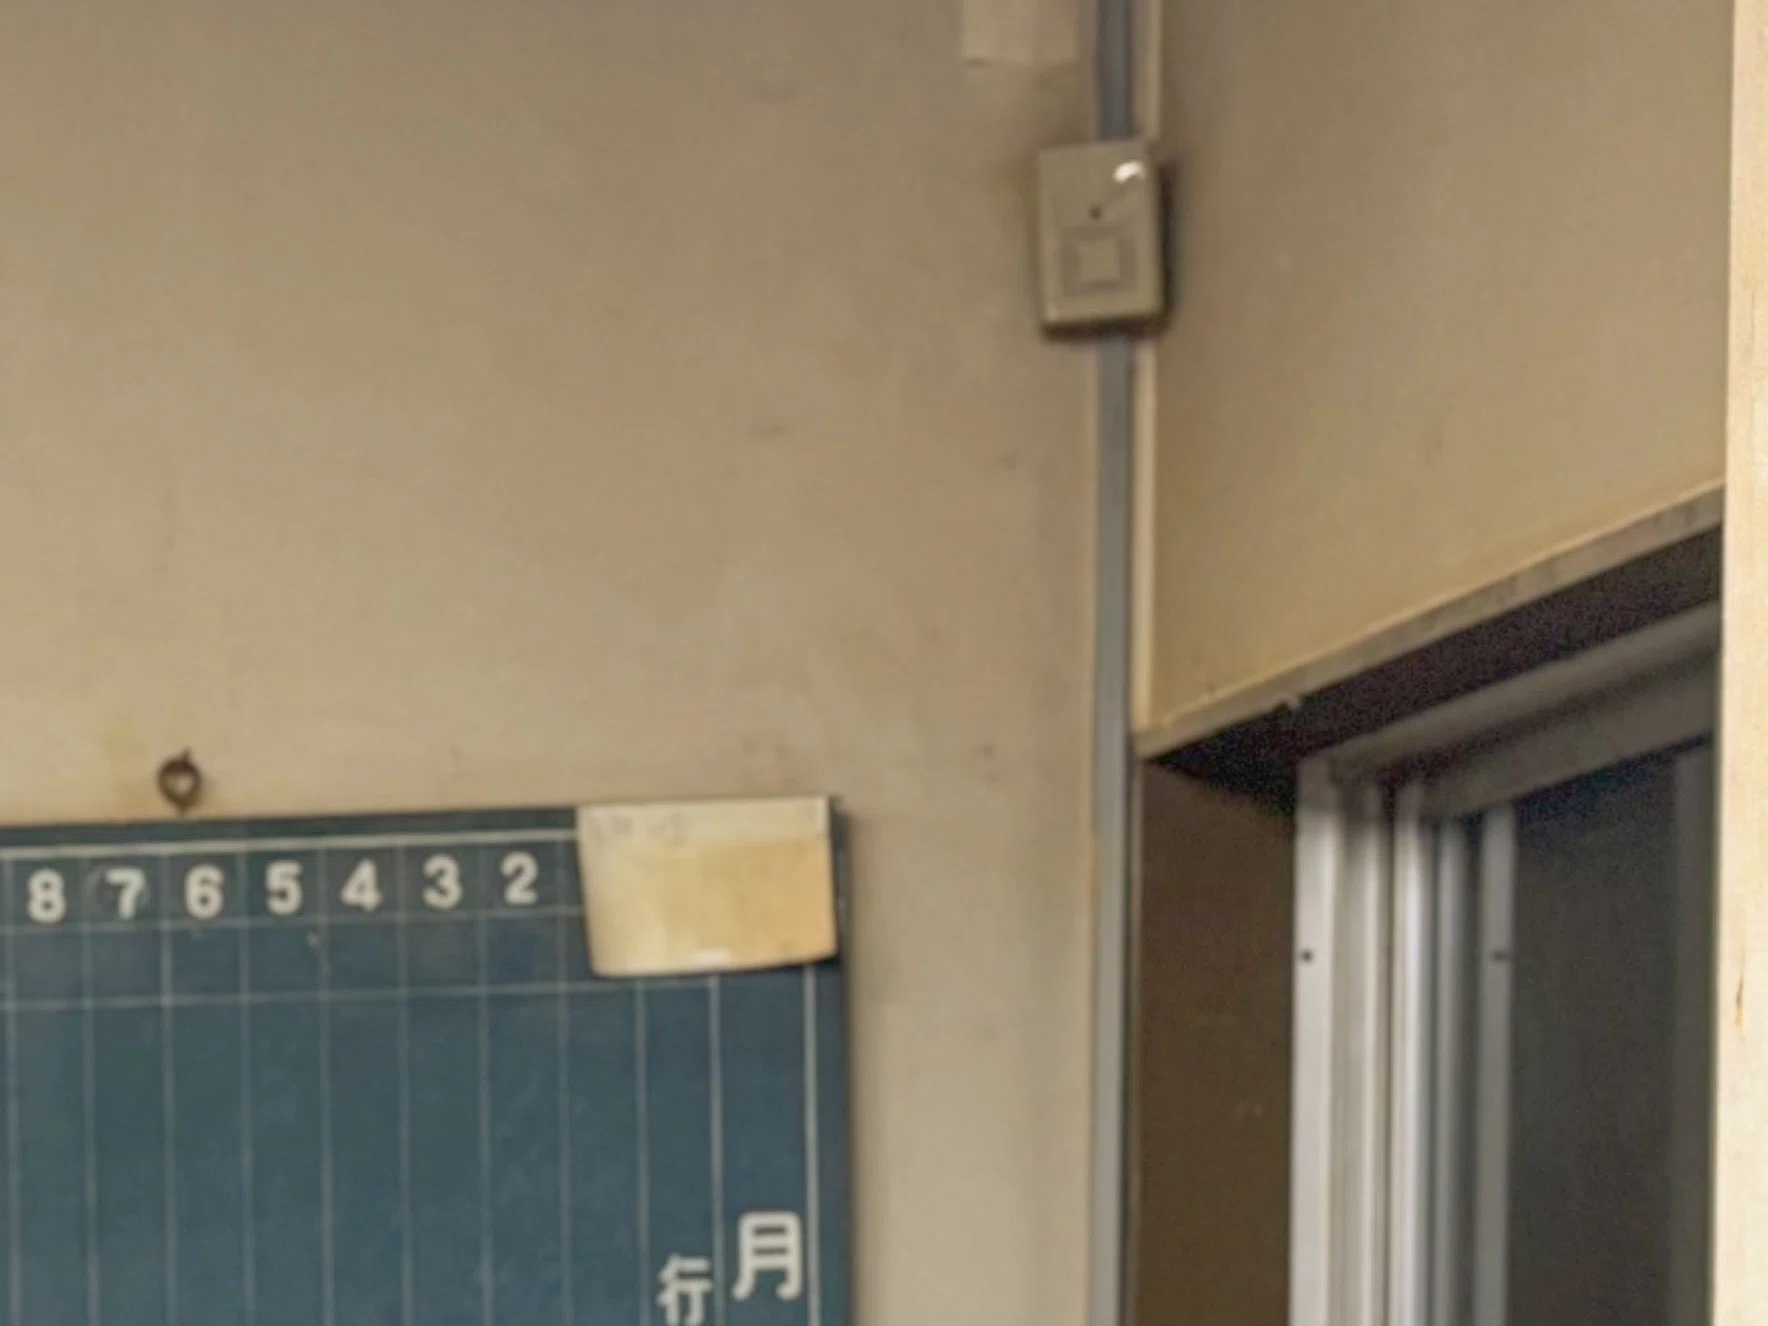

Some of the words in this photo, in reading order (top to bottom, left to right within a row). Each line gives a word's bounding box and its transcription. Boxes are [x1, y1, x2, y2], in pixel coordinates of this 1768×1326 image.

[27, 868, 67, 924] 8
[105, 866, 146, 920] 7
[184, 864, 224, 920] 6
[266, 860, 303, 915] 5
[340, 859, 383, 911] 4
[423, 854, 463, 910] 3
[500, 851, 538, 905] 2
